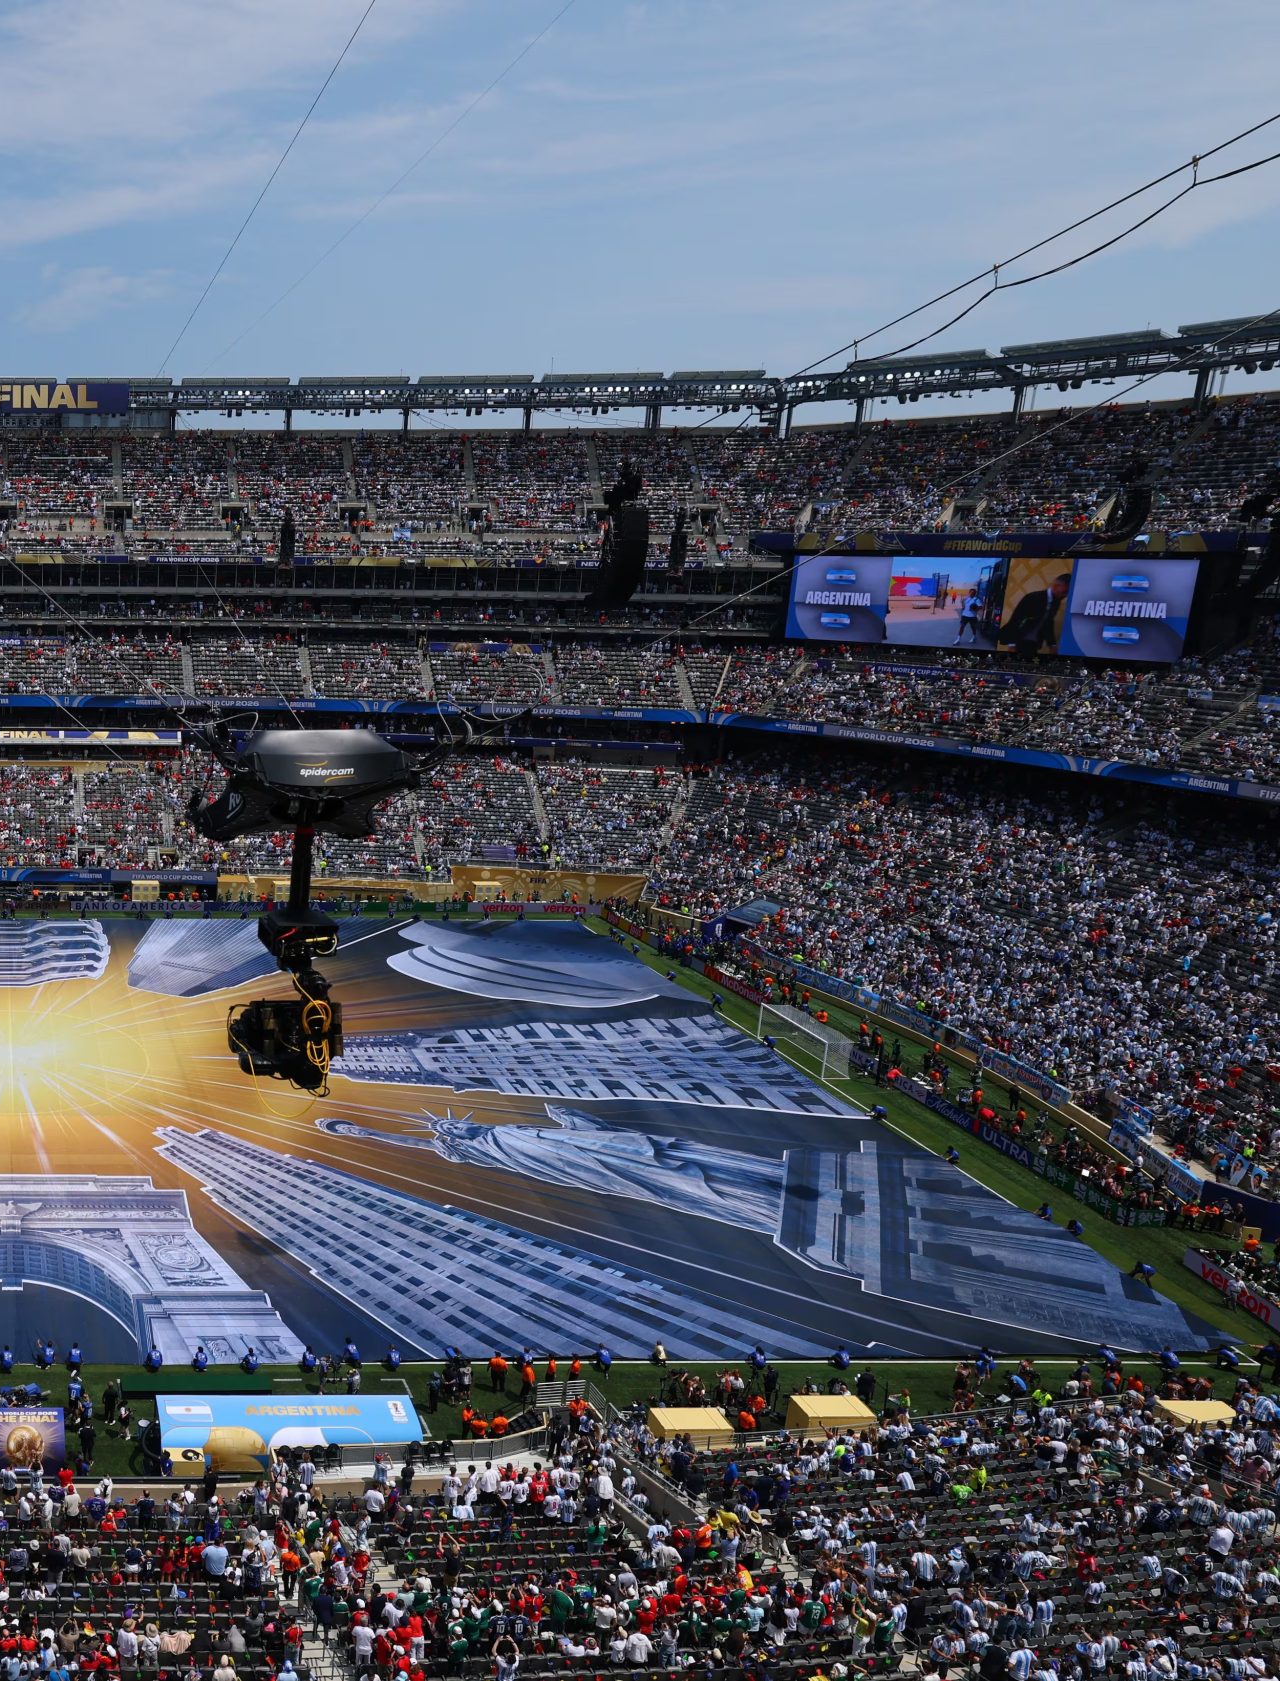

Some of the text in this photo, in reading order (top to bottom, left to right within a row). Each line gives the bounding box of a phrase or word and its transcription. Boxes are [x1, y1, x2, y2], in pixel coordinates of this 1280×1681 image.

[943, 540, 1023, 554] #FIFAWorldCup
[805, 591, 871, 606] ARGENTINA
[1084, 600, 1167, 619] ARGENTINA
[787, 723, 818, 733] ARGENTINA
[838, 729, 935, 747] FIFA WORLD CUP 2026
[970, 746, 1005, 758] ARGENTINA
[299, 765, 355, 778] spidercam
[1188, 777, 1229, 792] ARGENTINA
[529, 877, 547, 885] FIFA
[482, 903, 524, 913] verizon
[543, 904, 587, 914] verizon
[721, 974, 764, 1004] McDonald
[983, 1126, 1029, 1166] ULTRA
[1201, 1262, 1272, 1324] verzon
[245, 1405, 361, 1416] ARGENTINA
[20, 1415, 58, 1423] FINAL
[496, 1624, 506, 1635] 10
[514, 1623, 524, 1634] 10
